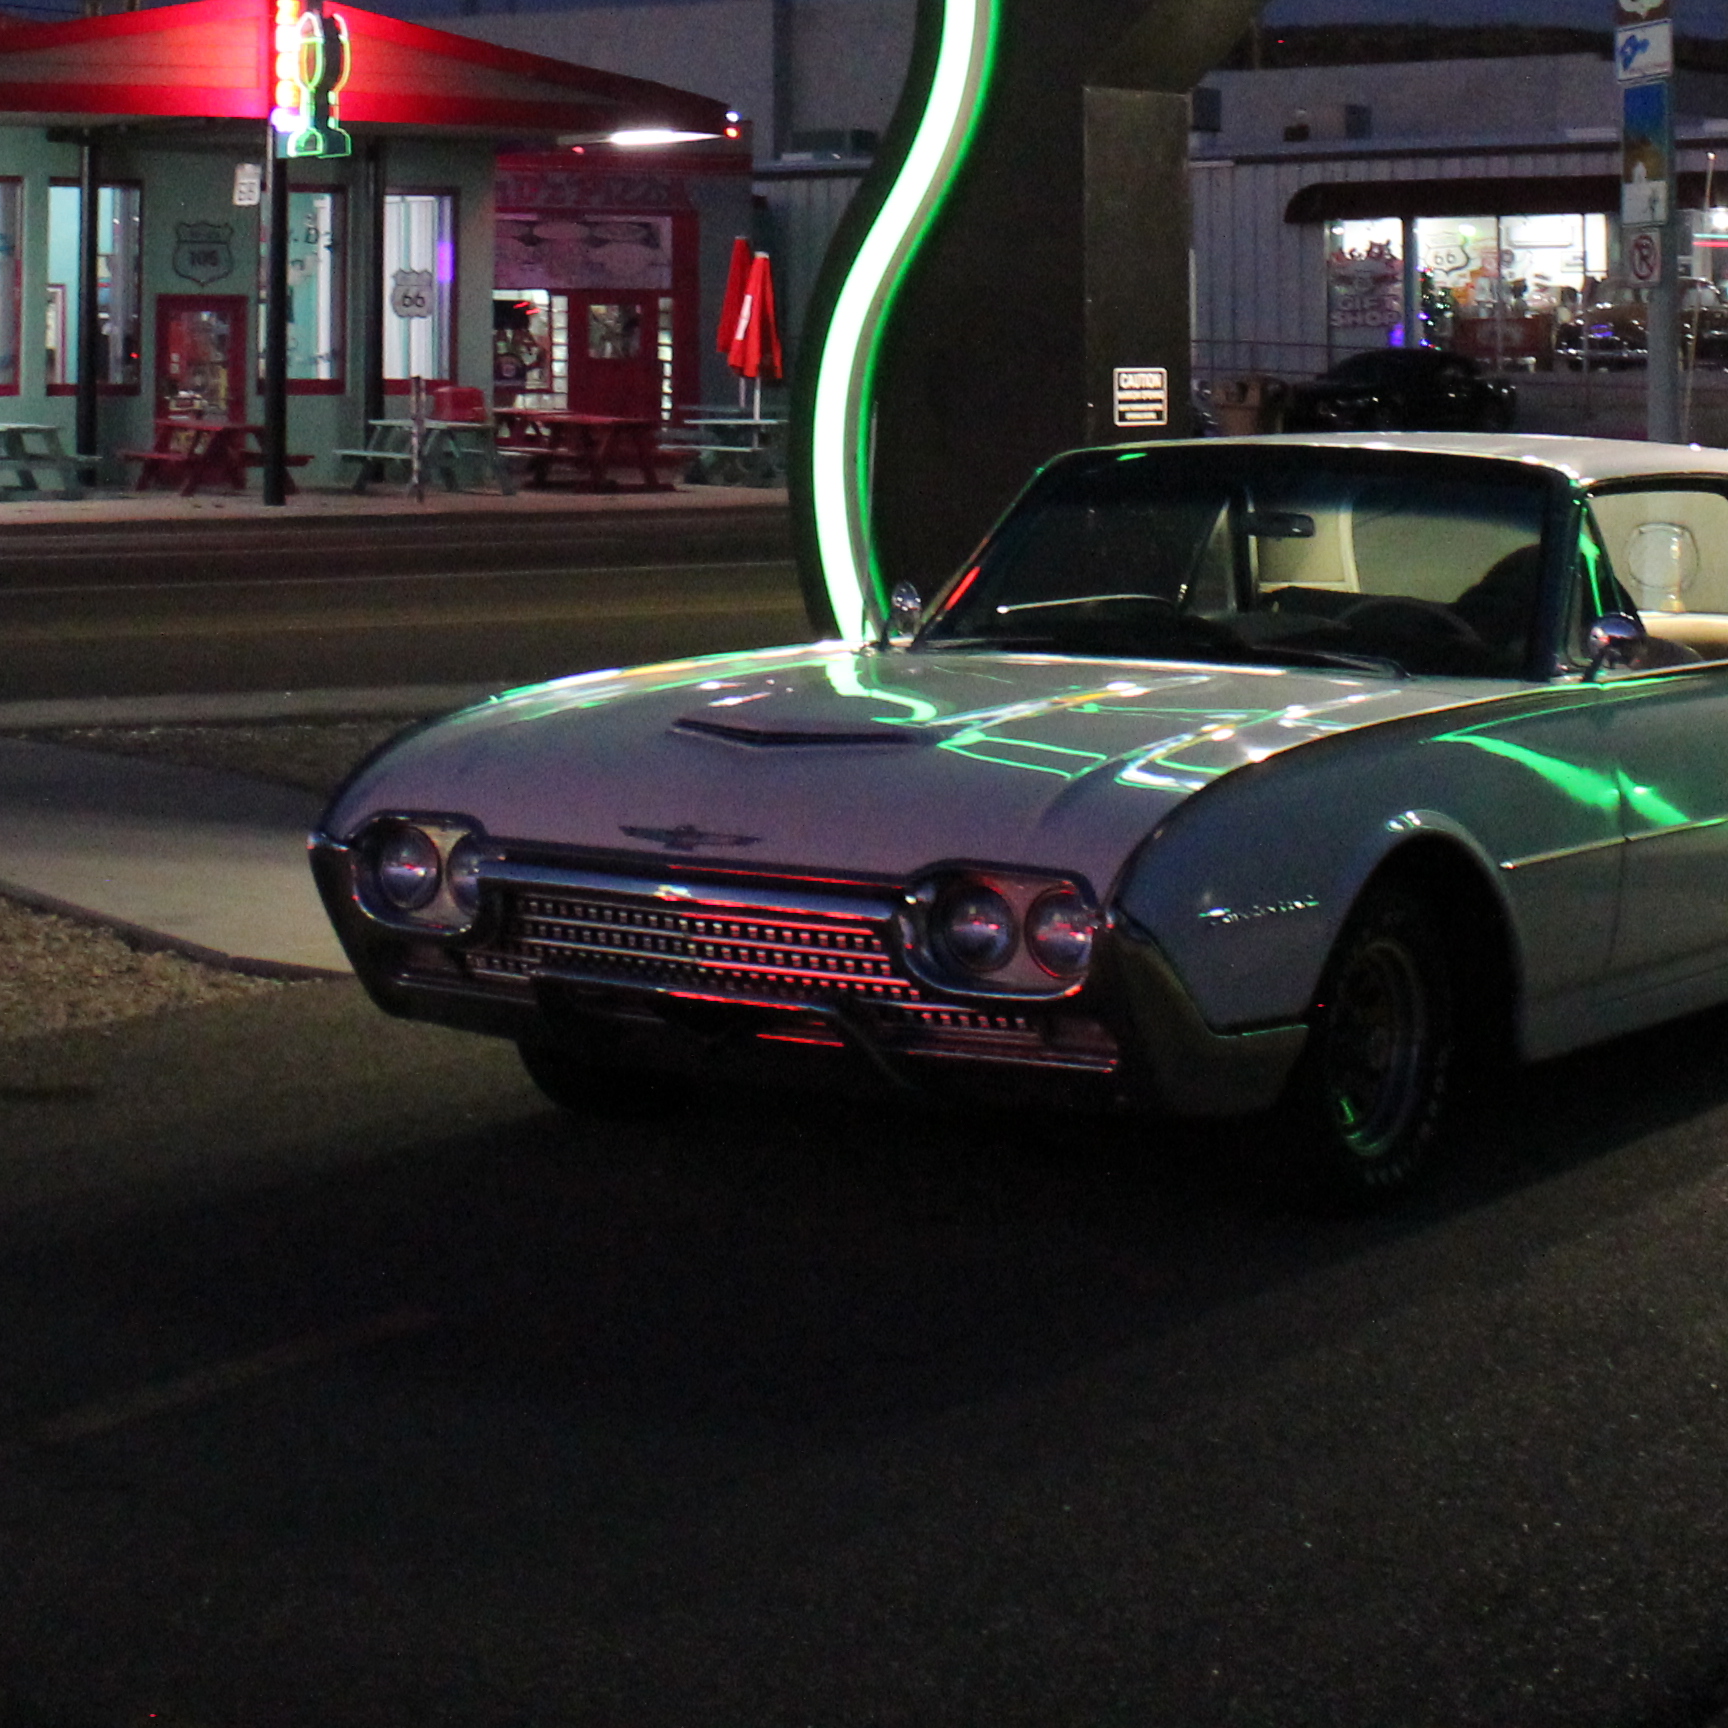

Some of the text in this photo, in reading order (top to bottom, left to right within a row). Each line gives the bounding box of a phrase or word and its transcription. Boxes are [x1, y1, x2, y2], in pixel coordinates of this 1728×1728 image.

[1434, 249, 1456, 265] 66
[402, 287, 426, 308] 66
[1338, 295, 1399, 310] GIFT
[1330, 310, 1401, 327] SHOP
[1119, 373, 1162, 389] CAUTION
